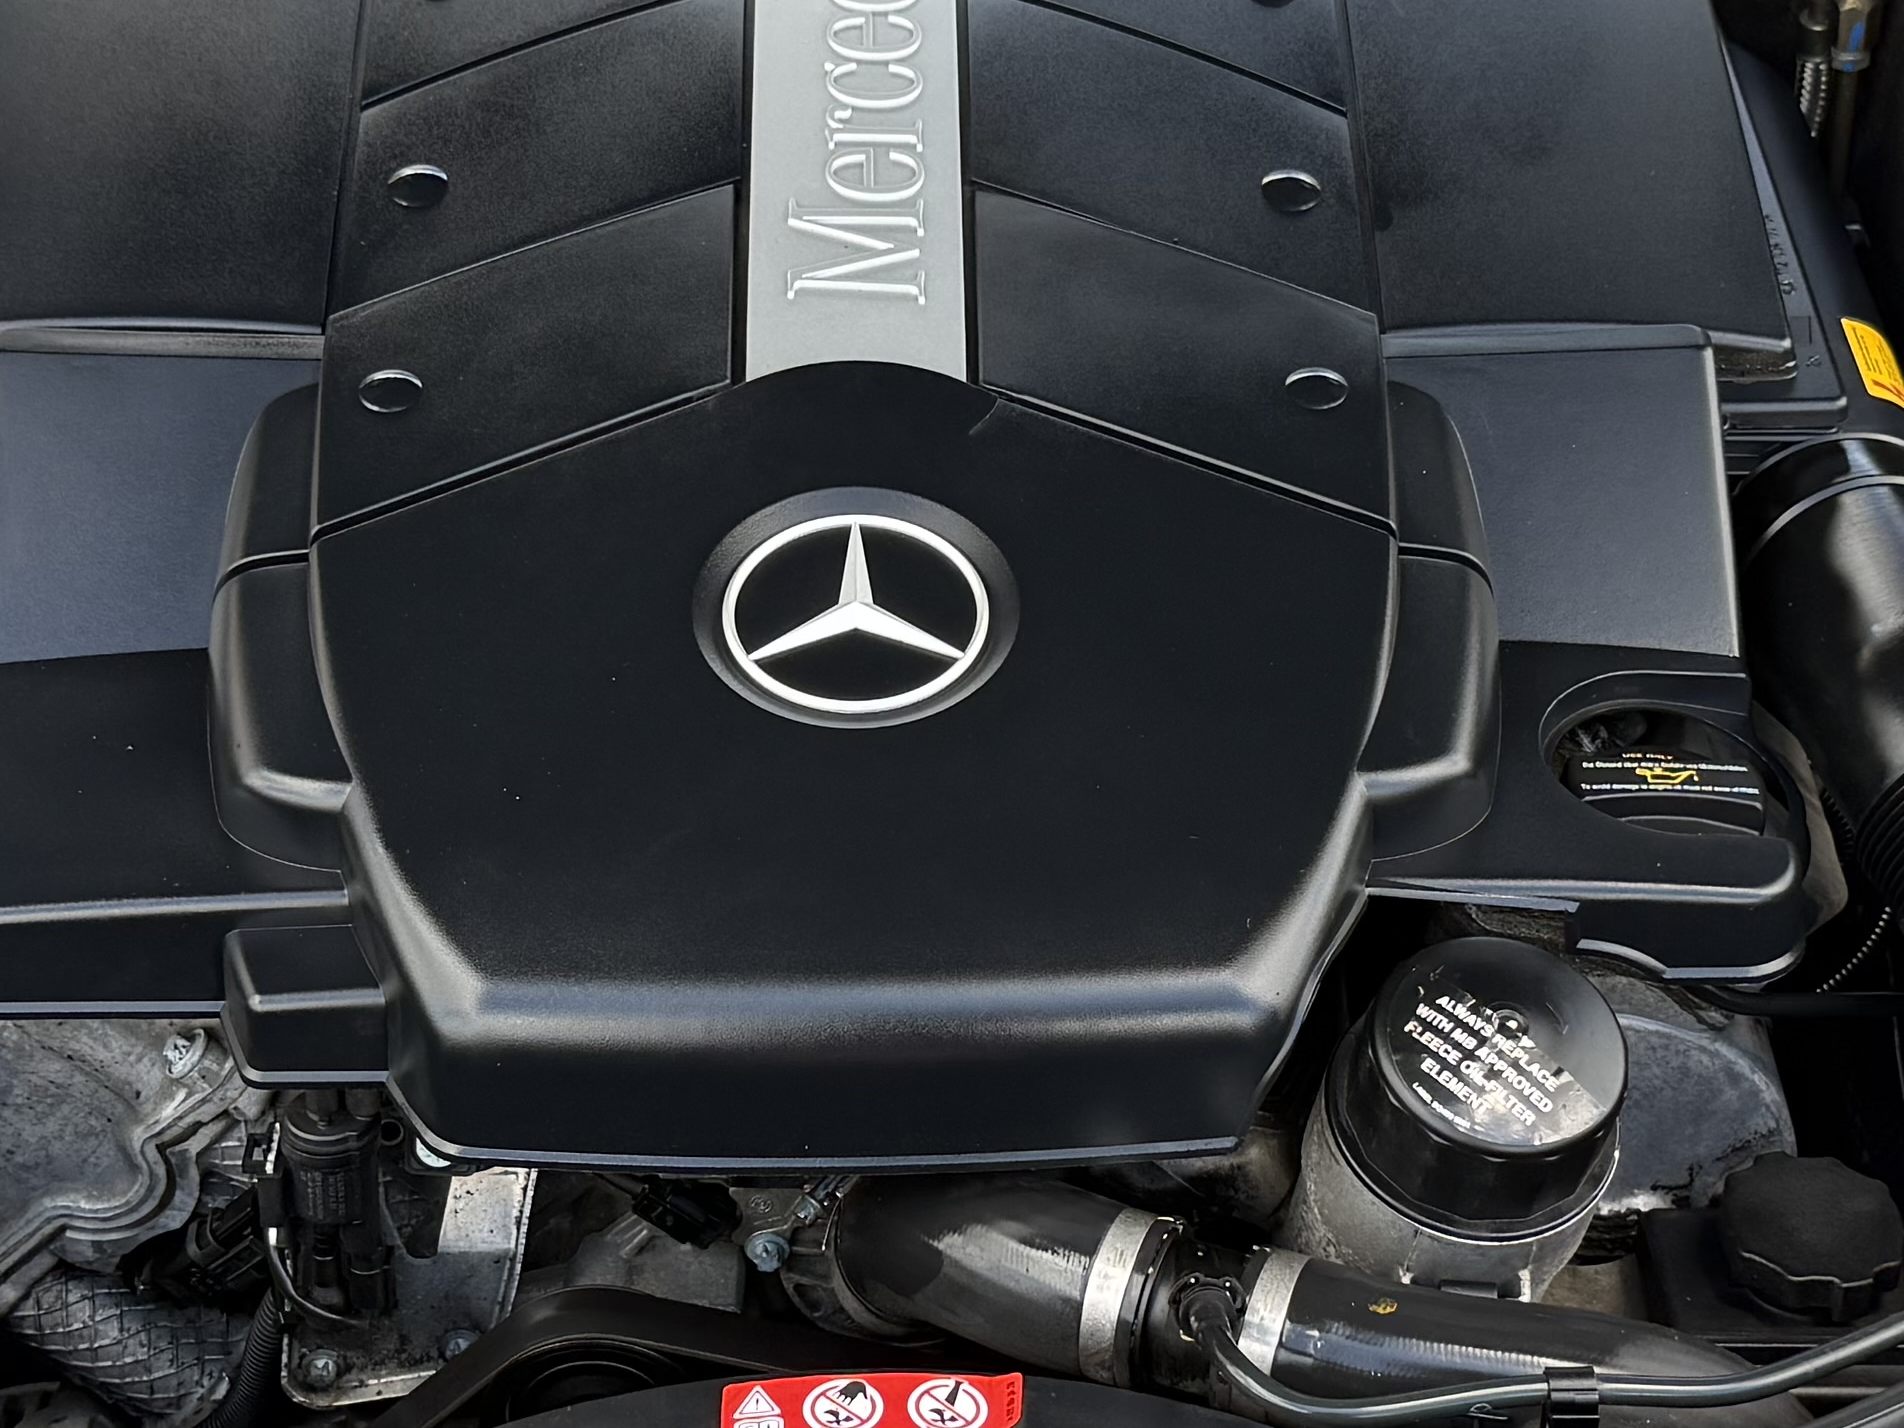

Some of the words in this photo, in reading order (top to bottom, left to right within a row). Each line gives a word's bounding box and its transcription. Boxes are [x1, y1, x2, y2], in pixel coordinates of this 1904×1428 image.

[1403, 1020, 1463, 1066] FLEECE
[1416, 1003, 1455, 1033] WITH
[1450, 1027, 1478, 1051] MB
[1474, 1046, 1554, 1113] APPROVED
[1435, 996, 1495, 1038] ALWAYS
[1492, 1033, 1560, 1093] REPLACE
[1420, 1057, 1493, 1116] ELEMENT
